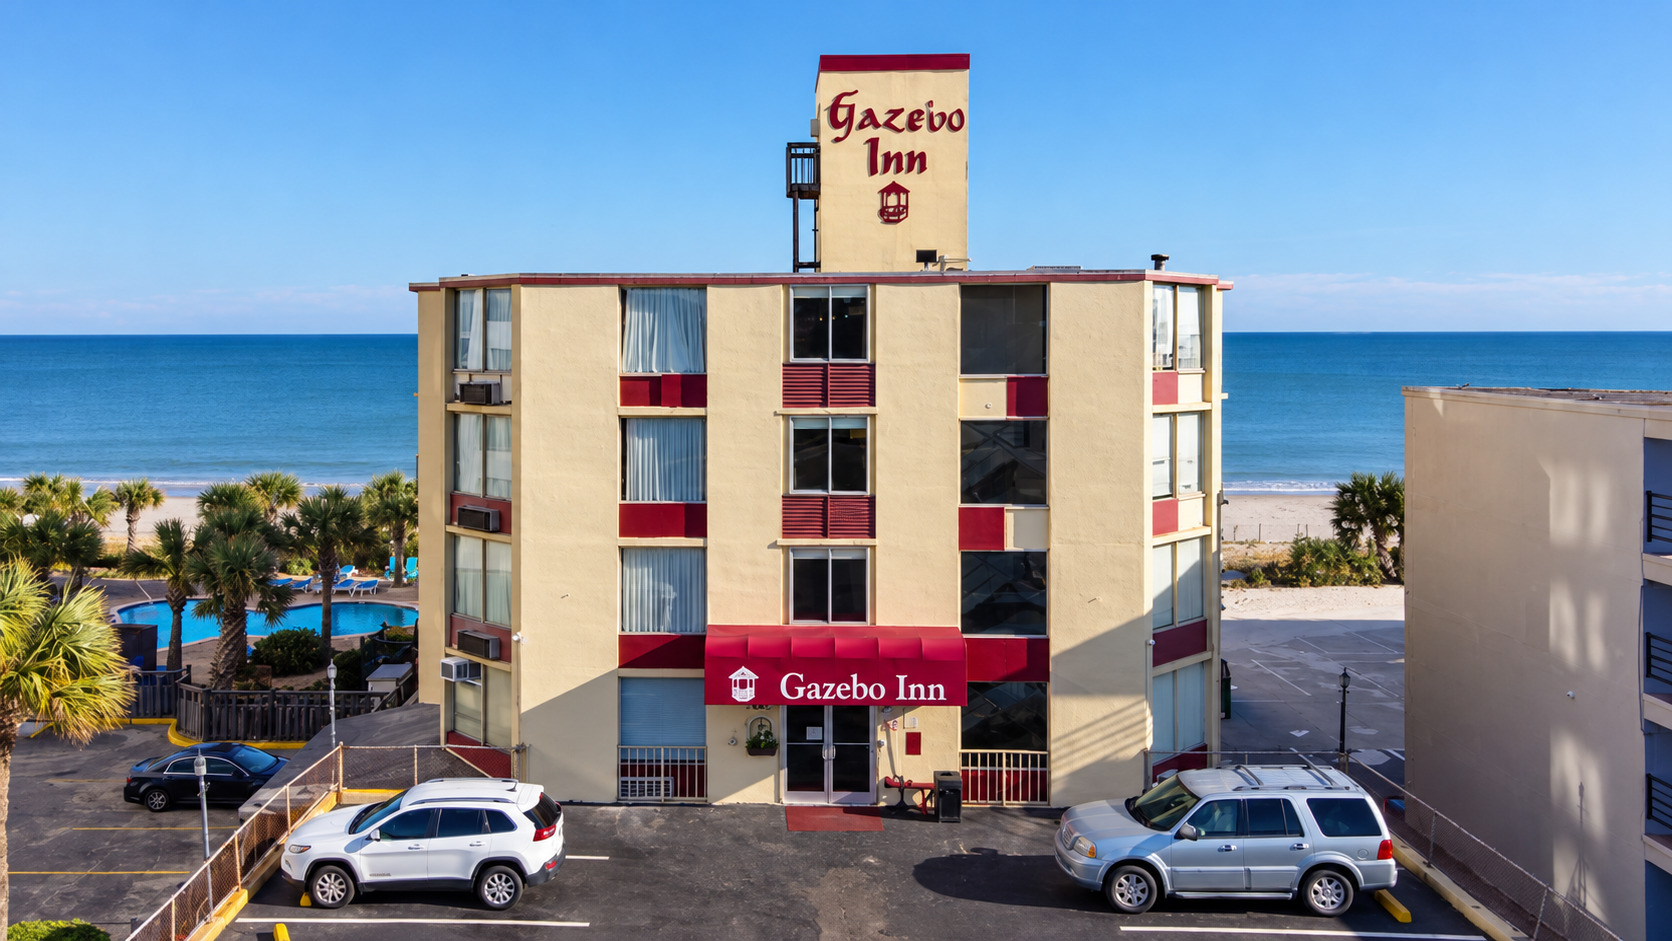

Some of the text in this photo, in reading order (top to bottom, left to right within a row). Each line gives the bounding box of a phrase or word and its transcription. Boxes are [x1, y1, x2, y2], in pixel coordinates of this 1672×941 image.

[827, 89, 965, 142] Gazebo
[865, 137, 927, 176] Inn
[780, 672, 947, 701] Gazebo Inn
